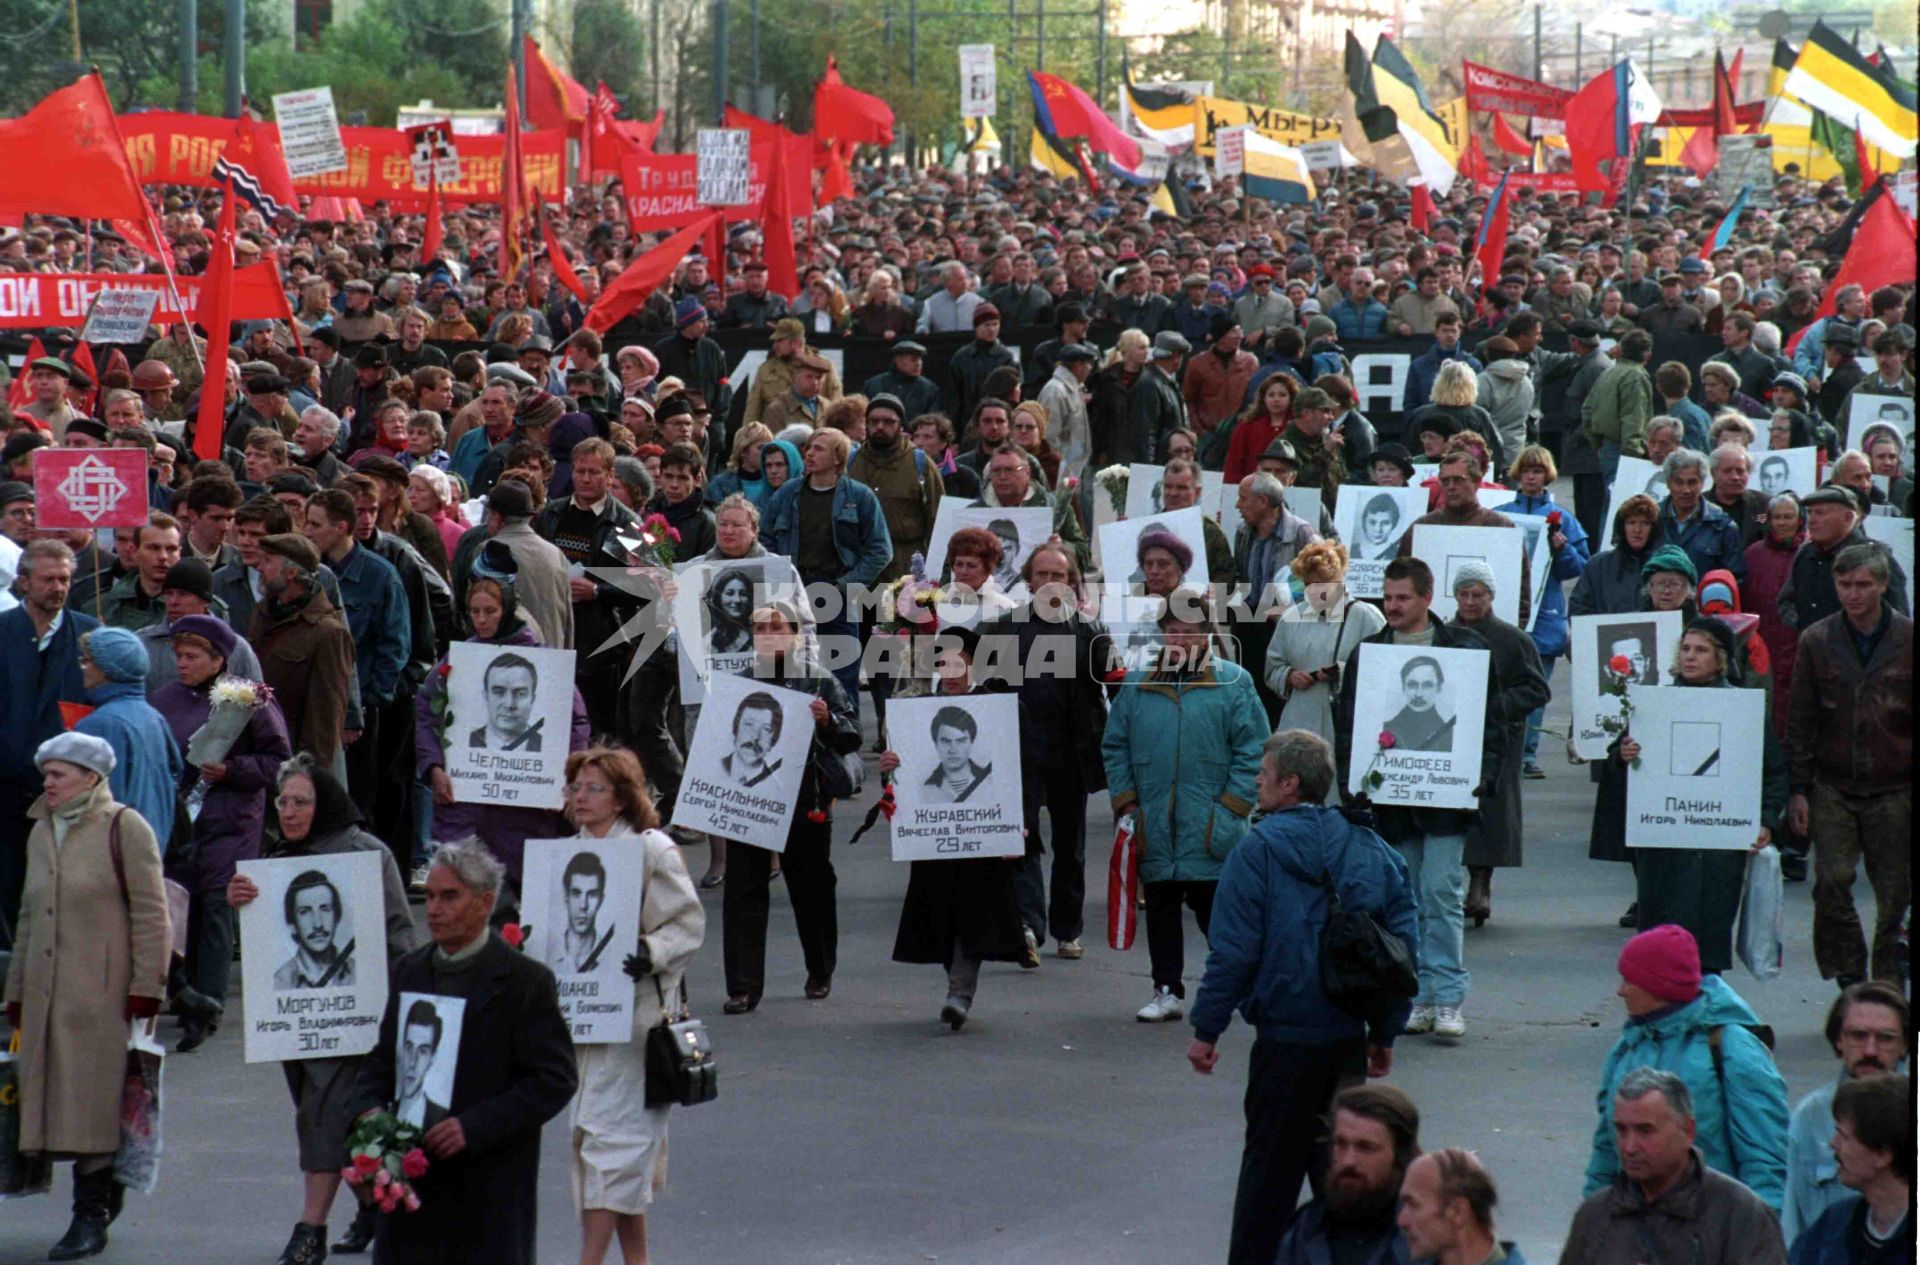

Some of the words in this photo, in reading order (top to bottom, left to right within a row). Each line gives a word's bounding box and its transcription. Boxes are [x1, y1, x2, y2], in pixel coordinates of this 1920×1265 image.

[469, 752, 543, 772] ЧЕЛЫШЕВ
[1382, 772, 1423, 785] ЕКСАНДР
[481, 783, 500, 798] 50
[689, 777, 786, 815] КРАСИЛЬНИКОВ
[1388, 784, 1411, 799] 35
[915, 803, 1002, 824] ЖУРАВСКИЙ
[1665, 797, 1722, 813] ПАНИН
[708, 813, 727, 830] 45
[936, 837, 959, 853] 29
[277, 995, 356, 1014] МОРГУНОВ
[298, 1033, 319, 1051] 30
